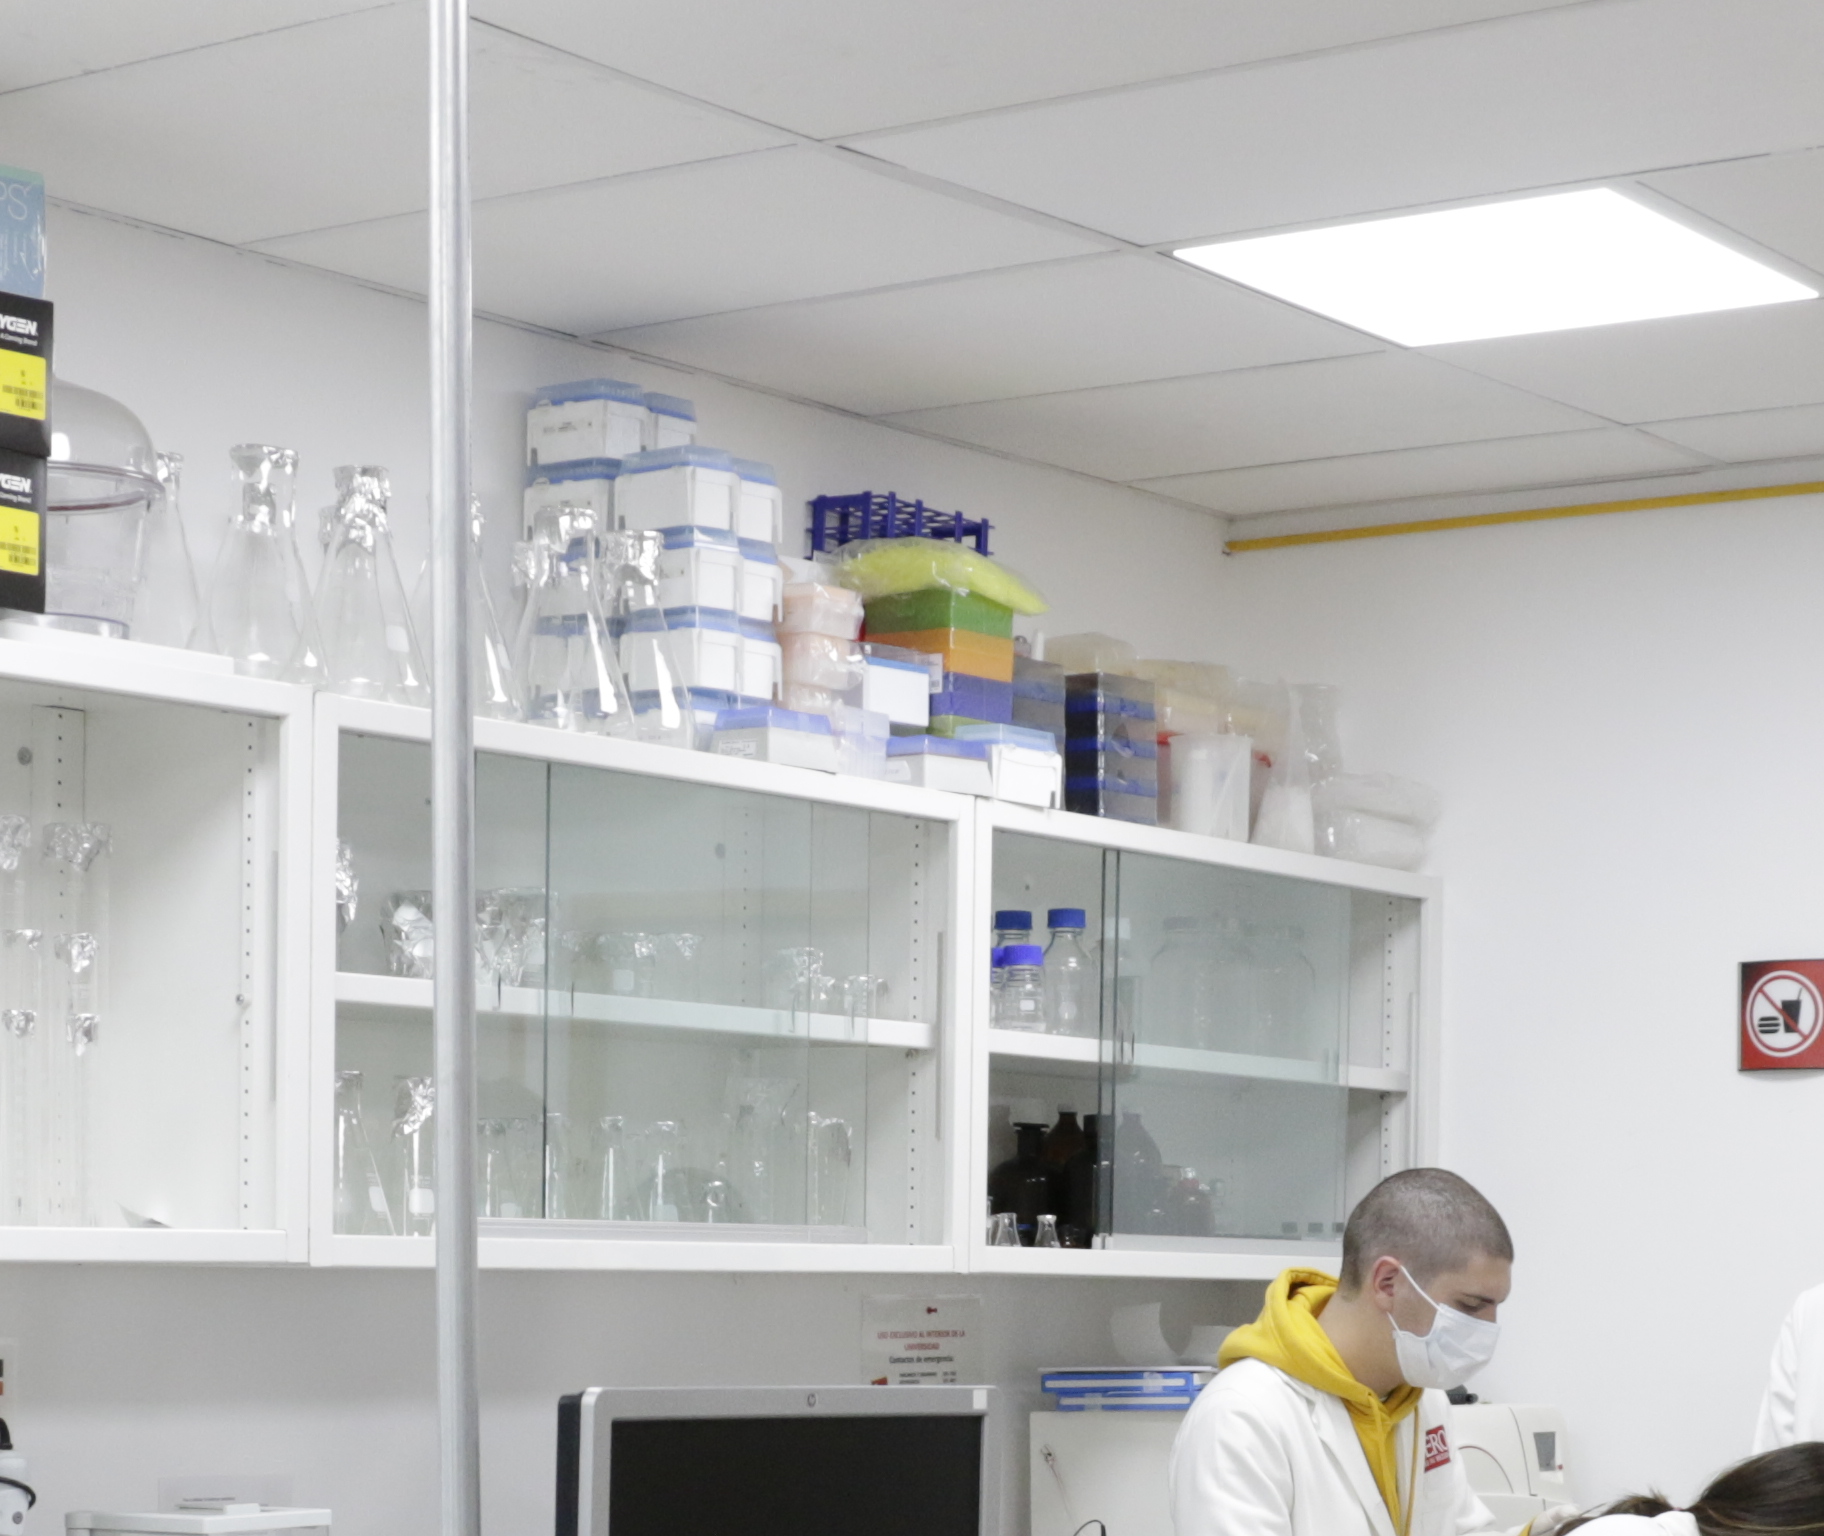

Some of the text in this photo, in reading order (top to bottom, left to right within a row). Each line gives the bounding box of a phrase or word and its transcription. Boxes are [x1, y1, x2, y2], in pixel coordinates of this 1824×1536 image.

[904, 1343, 940, 1351] UNIVERSIDAD
[889, 1356, 915, 1364] Contactos
[923, 1355, 954, 1364] emergencia
